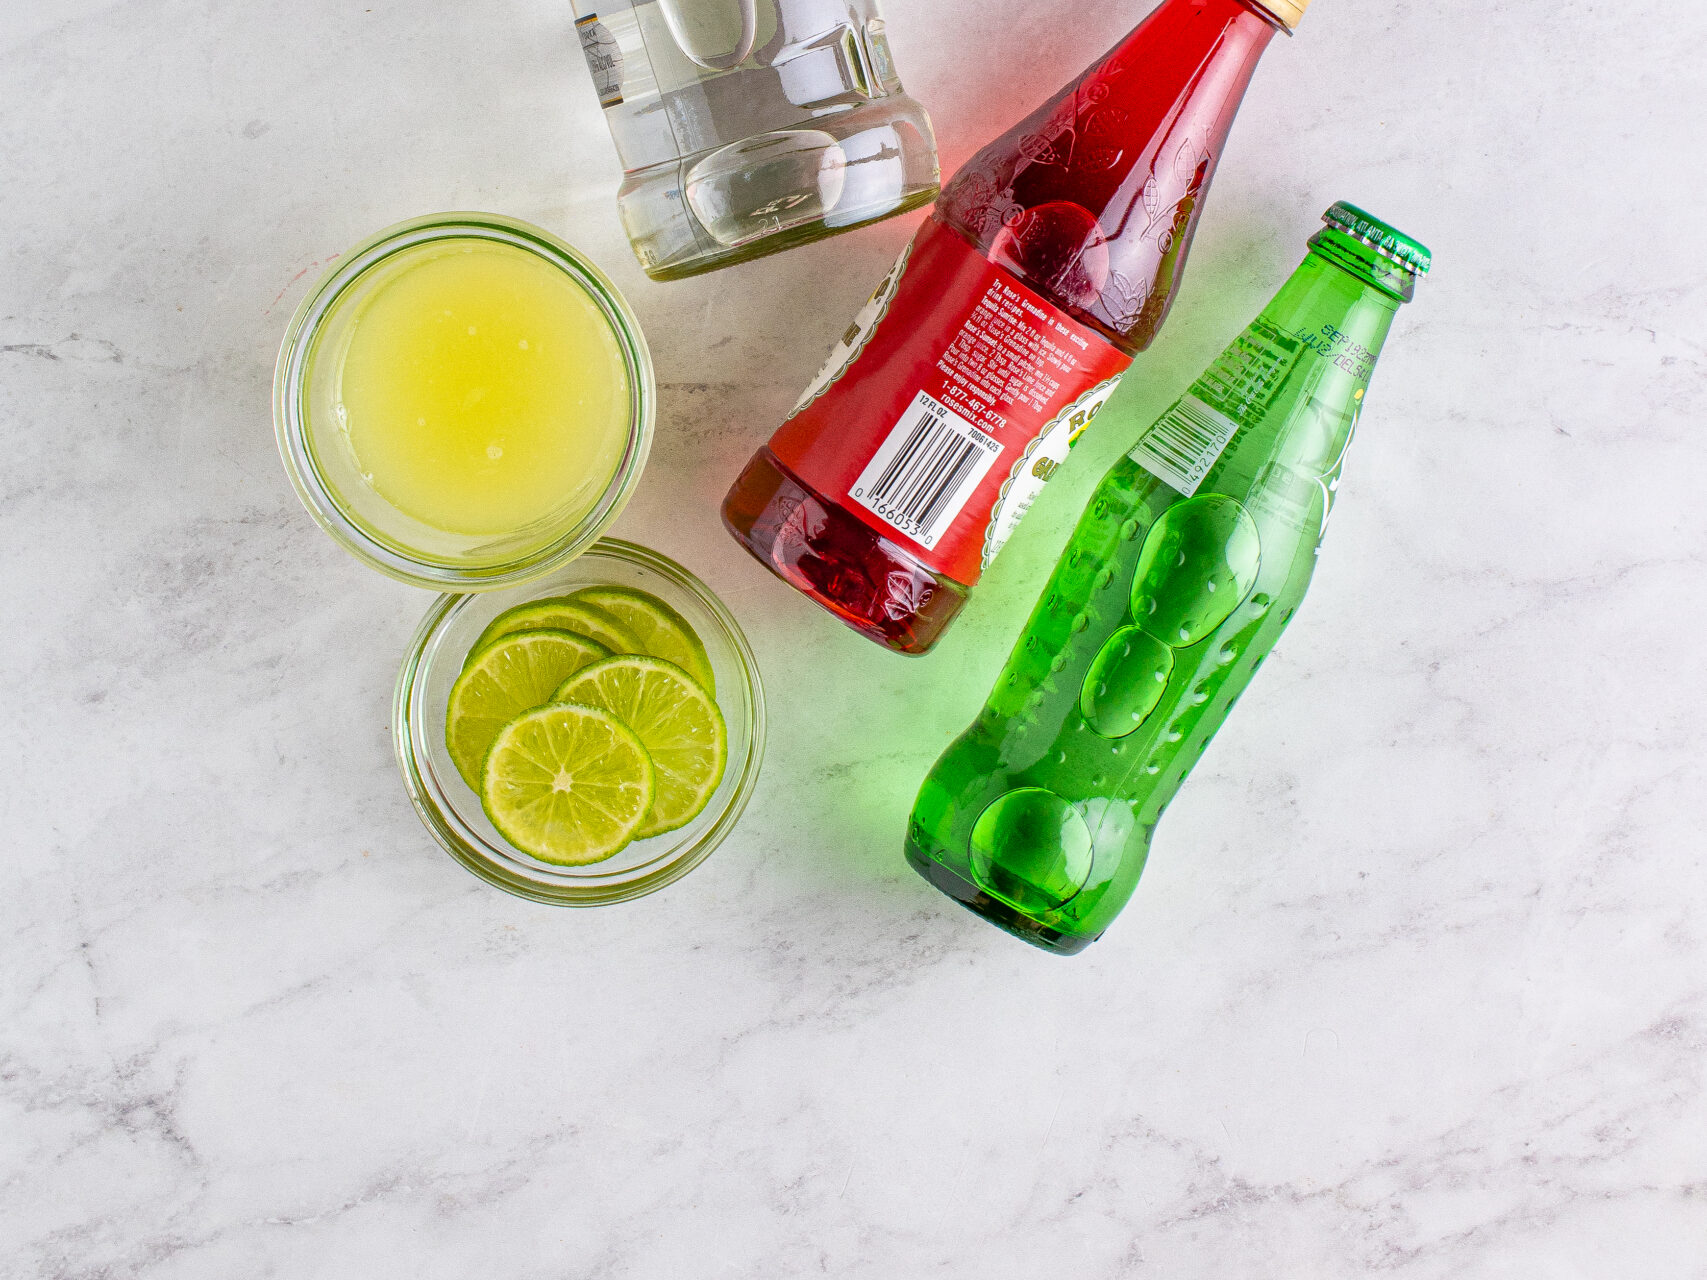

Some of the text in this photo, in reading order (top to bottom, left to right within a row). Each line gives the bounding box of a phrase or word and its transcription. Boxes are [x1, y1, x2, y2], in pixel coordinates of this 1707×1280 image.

[980, 296, 1000, 314] Tequila
[997, 308, 1019, 326] Sunrise:
[1025, 327, 1032, 335] 2
[1039, 336, 1057, 352] Tequila
[1055, 348, 1065, 357] and
[986, 288, 1025, 319] drink recipes.
[992, 279, 1089, 350] Try Rose's Grenadine in these exciting
[958, 329, 977, 345] orange
[975, 340, 991, 355] juice,
[1007, 362, 1024, 377] Rose's
[1022, 373, 1036, 385] Lime
[1045, 388, 1055, 397] and
[964, 320, 982, 336] Rose's
[979, 331, 999, 348] Sunset:
[1005, 349, 1021, 363] small
[1049, 380, 1060, 390] cups
[974, 305, 993, 321] orange
[992, 316, 1006, 329] juice
[1013, 332, 1029, 346] glass
[1027, 340, 1040, 352] with
[1046, 353, 1062, 368] Slowly
[1060, 363, 1071, 374] pour
[980, 320, 988, 328] oz
[987, 324, 1005, 339] Rose's
[1003, 335, 1030, 357] Grenadine
[1034, 357, 1046, 368] top.
[936, 360, 998, 407] Please enjoy responsibly.
[942, 351, 1016, 407] Rose's Grenadine into each glass.
[948, 343, 961, 356] Pour
[958, 351, 970, 362] into
[968, 358, 979, 368] two
[980, 367, 988, 375] oz
[985, 371, 1006, 388] glasses.
[1004, 383, 1020, 398] Gently
[1018, 393, 1029, 404] pour
[971, 350, 988, 365] sugar.
[987, 360, 998, 371] Stir
[997, 367, 1010, 379] until
[1009, 376, 1024, 389] sugar
[1023, 384, 1029, 392] is
[1028, 388, 1049, 405] dissolved.
[919, 395, 948, 418] 12 FL OZ
[941, 379, 1007, 429] 1-877-467-6778
[941, 392, 995, 434] rosesmix.com
[967, 428, 1000, 453] 70061425
[1181, 486, 1191, 495] 0
[1188, 433, 1227, 484] 492170
[854, 487, 933, 545] 0 166053 0
